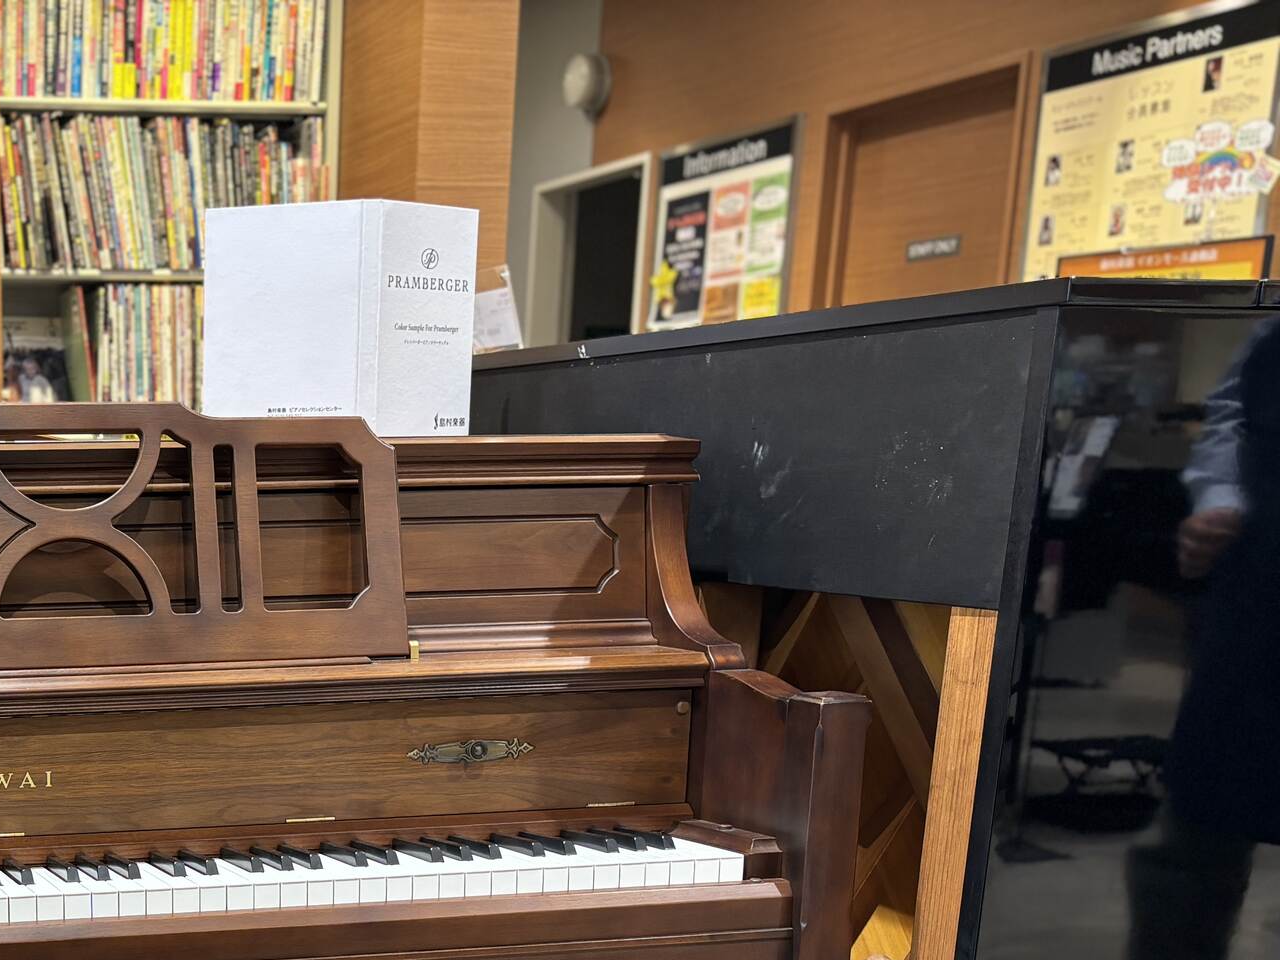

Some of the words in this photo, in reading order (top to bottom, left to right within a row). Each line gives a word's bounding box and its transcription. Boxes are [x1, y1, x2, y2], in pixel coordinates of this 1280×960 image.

[1091, 44, 1143, 76] Music
[1145, 24, 1224, 62] Partners
[682, 138, 768, 178] Information
[387, 274, 469, 293] PRAMBERGER
[394, 322, 408, 331] Color
[408, 323, 424, 334] Sample
[425, 323, 433, 332] For
[433, 324, 459, 335] Pramberger
